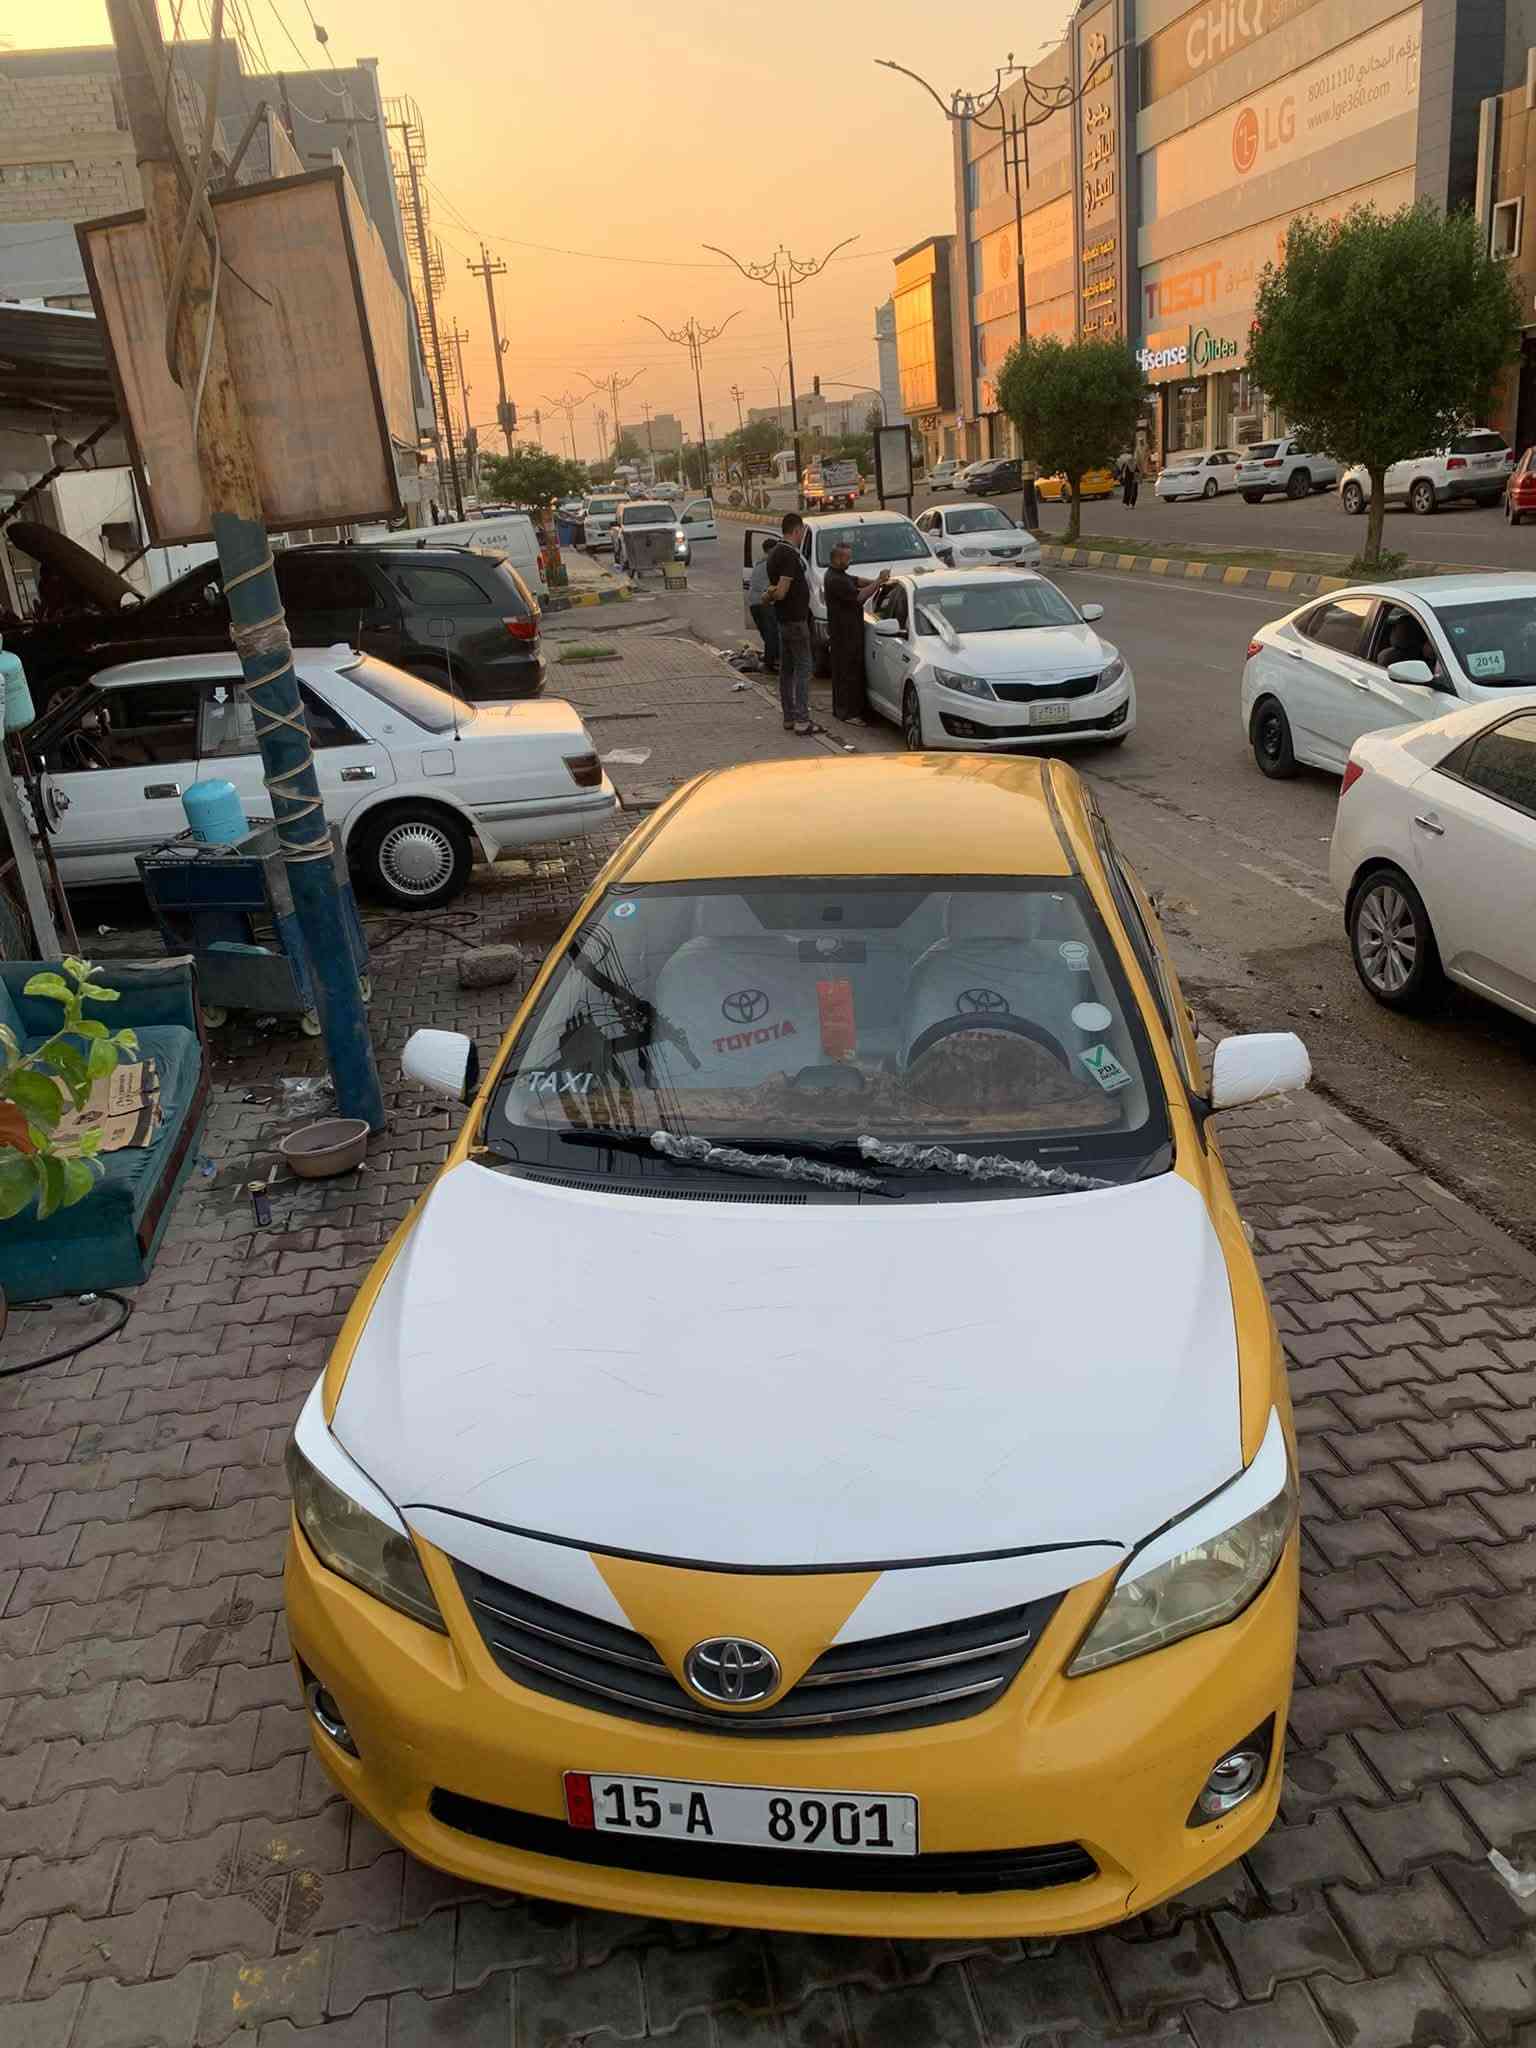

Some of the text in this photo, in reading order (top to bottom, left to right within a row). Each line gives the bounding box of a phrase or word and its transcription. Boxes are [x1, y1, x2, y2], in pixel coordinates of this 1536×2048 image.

[1264, 96, 1296, 151] LG
[1136, 345, 1187, 371] Hisense
[1477, 655, 1500, 668] 2014
[713, 1020, 797, 1052] TOYOTA
[528, 1071, 593, 1093] TAXI
[768, 1797, 894, 1848] 8901
